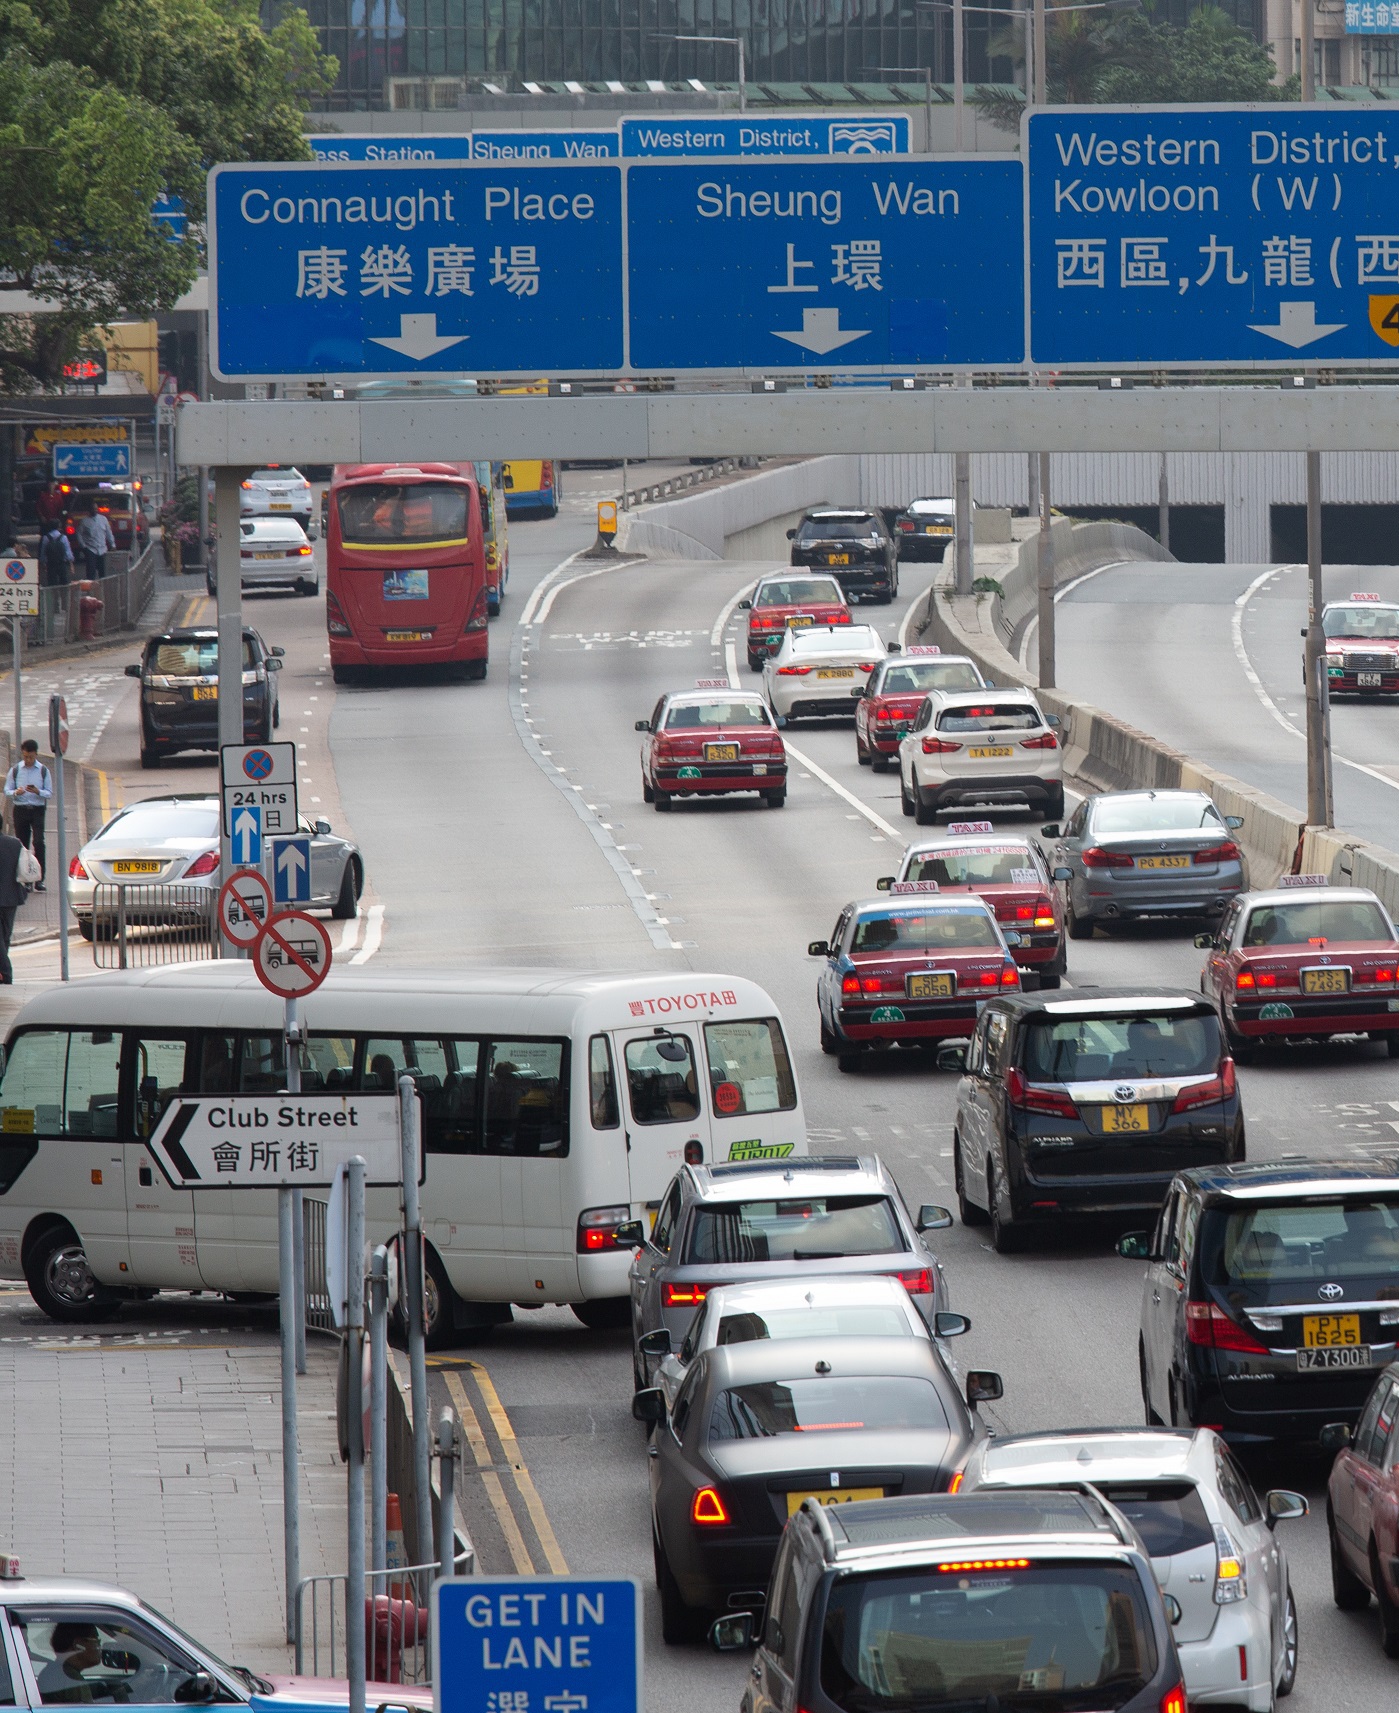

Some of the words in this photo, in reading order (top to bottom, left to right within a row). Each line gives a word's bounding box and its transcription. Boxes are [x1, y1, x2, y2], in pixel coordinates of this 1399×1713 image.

[638, 129, 725, 148] Western
[739, 127, 820, 149] District,
[365, 145, 435, 160] Station
[474, 140, 550, 158] Sheung
[564, 141, 610, 158] Wan
[1057, 135, 1220, 166] Western
[1057, 181, 1218, 212] Kowloon
[243, 190, 454, 231] Connaught
[487, 189, 594, 220] Place
[699, 184, 841, 225] Sheung
[874, 184, 959, 215] Wan
[298, 245, 540, 299] 康樂廣場
[769, 242, 882, 293] 上環
[0, 588, 13, 598] 24
[16, 588, 34, 598] hrs
[2, 600, 30, 612] 全日
[710, 752, 734, 761] 5420
[974, 747, 986, 757] TA
[988, 746, 1010, 756] 1222
[234, 792, 257, 806] 24
[261, 791, 287, 805] hrs
[266, 810, 281, 828] 日
[952, 823, 991, 835] TAXI
[117, 862, 131, 872] BN
[135, 860, 158, 871] 9818
[1140, 859, 1155, 869] PG
[1159, 857, 1188, 868] 4337
[894, 881, 938, 894] TAXI
[1283, 876, 1326, 887] TAXI
[924, 975, 939, 986] SP
[1318, 970, 1334, 981] PS
[914, 985, 949, 997] 5059
[1309, 980, 1343, 992] 7495
[644, 992, 723, 1015] TOYOTA
[721, 990, 738, 1005] 田
[208, 1107, 269, 1128] Club
[277, 1106, 359, 1128] Street
[1115, 1105, 1134, 1118] MY
[1111, 1117, 1141, 1131] 366
[211, 1141, 319, 1173] 會所街
[1319, 1316, 1344, 1332] PT
[1308, 1330, 1356, 1346] 1625
[1227, 1373, 1276, 1381] ALPHARD
[465, 1593, 547, 1628] GET
[560, 1592, 605, 1626] IN
[483, 1636, 591, 1670] LANE
